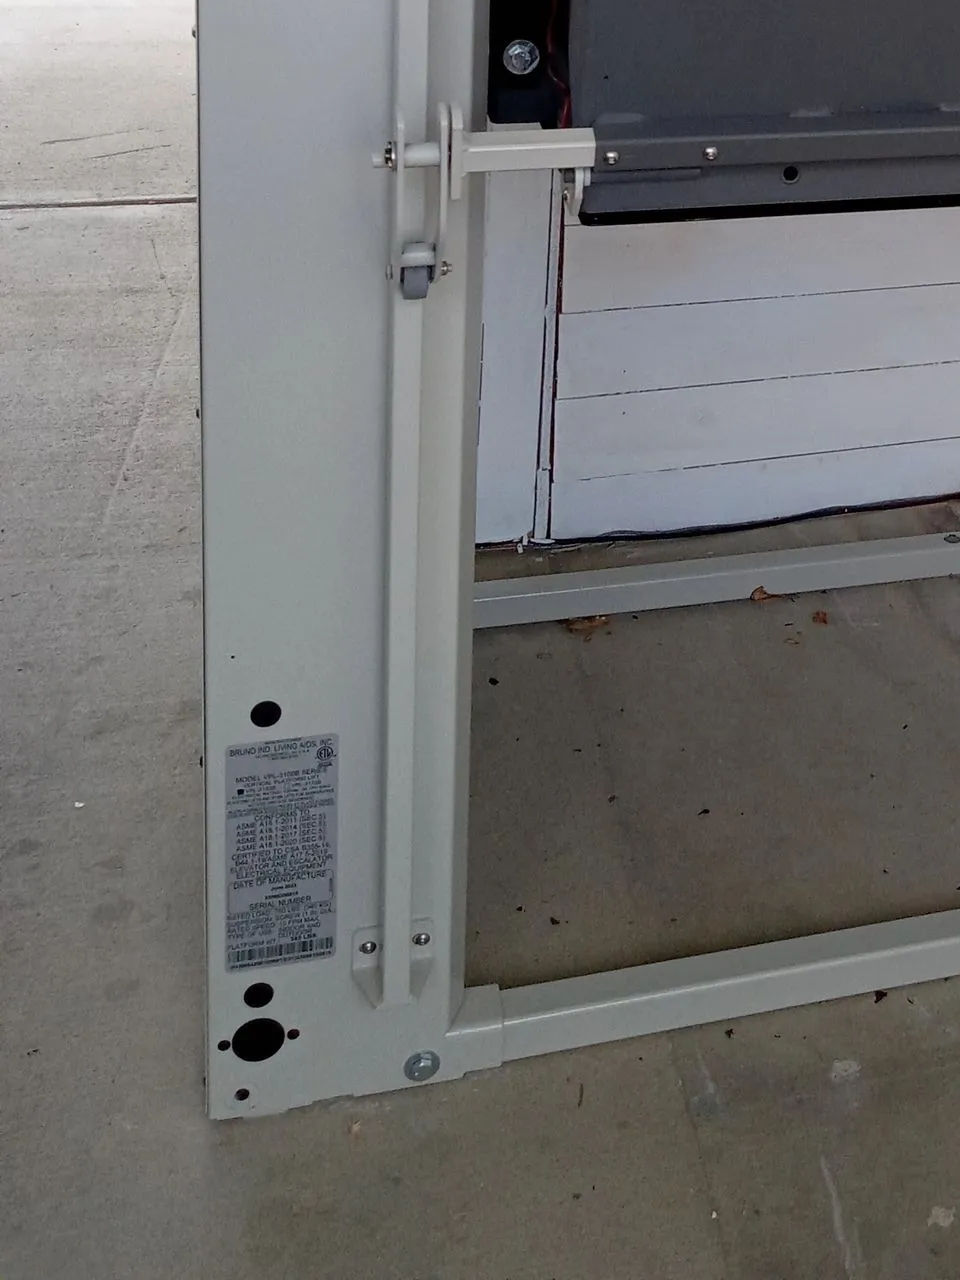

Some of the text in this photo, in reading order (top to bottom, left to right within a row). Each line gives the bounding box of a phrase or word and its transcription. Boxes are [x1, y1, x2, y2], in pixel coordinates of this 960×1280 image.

[229, 747, 256, 757] BRUNO
[274, 742, 297, 752] LIVING
[235, 775, 260, 783] MODEL
[233, 879, 253, 889] DATE
[249, 896, 311, 910] SERIAL NUMBER
